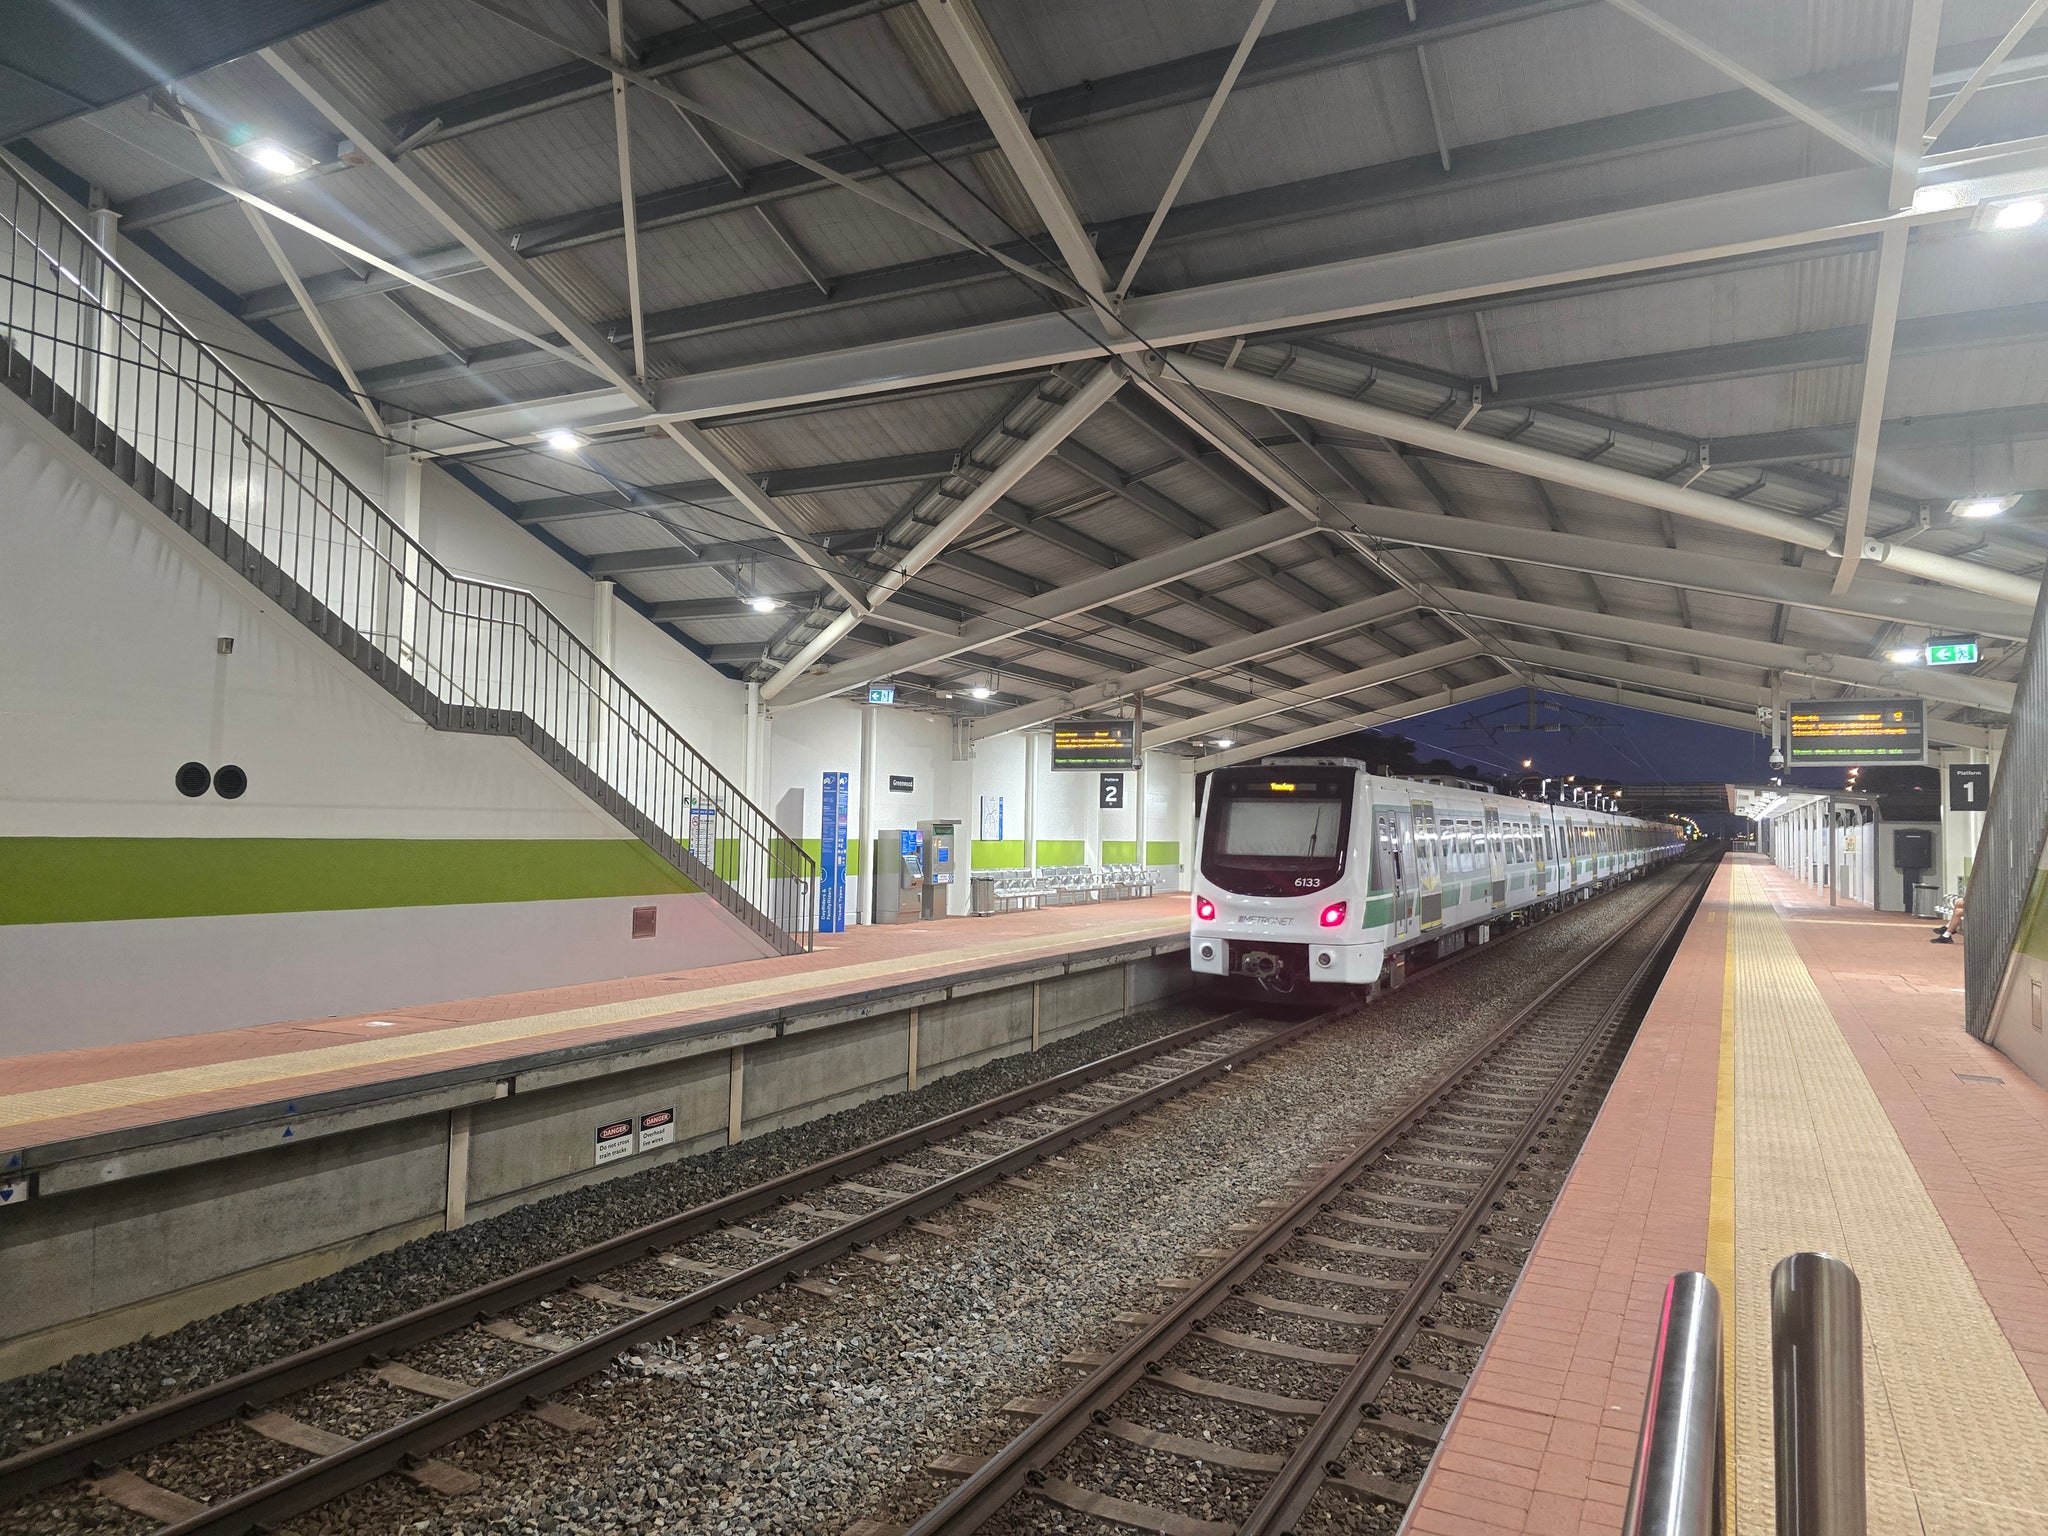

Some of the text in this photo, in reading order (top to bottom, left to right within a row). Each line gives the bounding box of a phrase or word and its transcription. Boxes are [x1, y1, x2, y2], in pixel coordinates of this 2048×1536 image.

[1105, 785, 1117, 802] 2
[1963, 781, 1974, 802] 1
[1294, 877, 1321, 888] 6133
[646, 1113, 669, 1125] DANGER
[603, 1125, 627, 1137] DANGER
[643, 1129, 665, 1139] Overhead
[599, 1147, 627, 1160] train tracks
